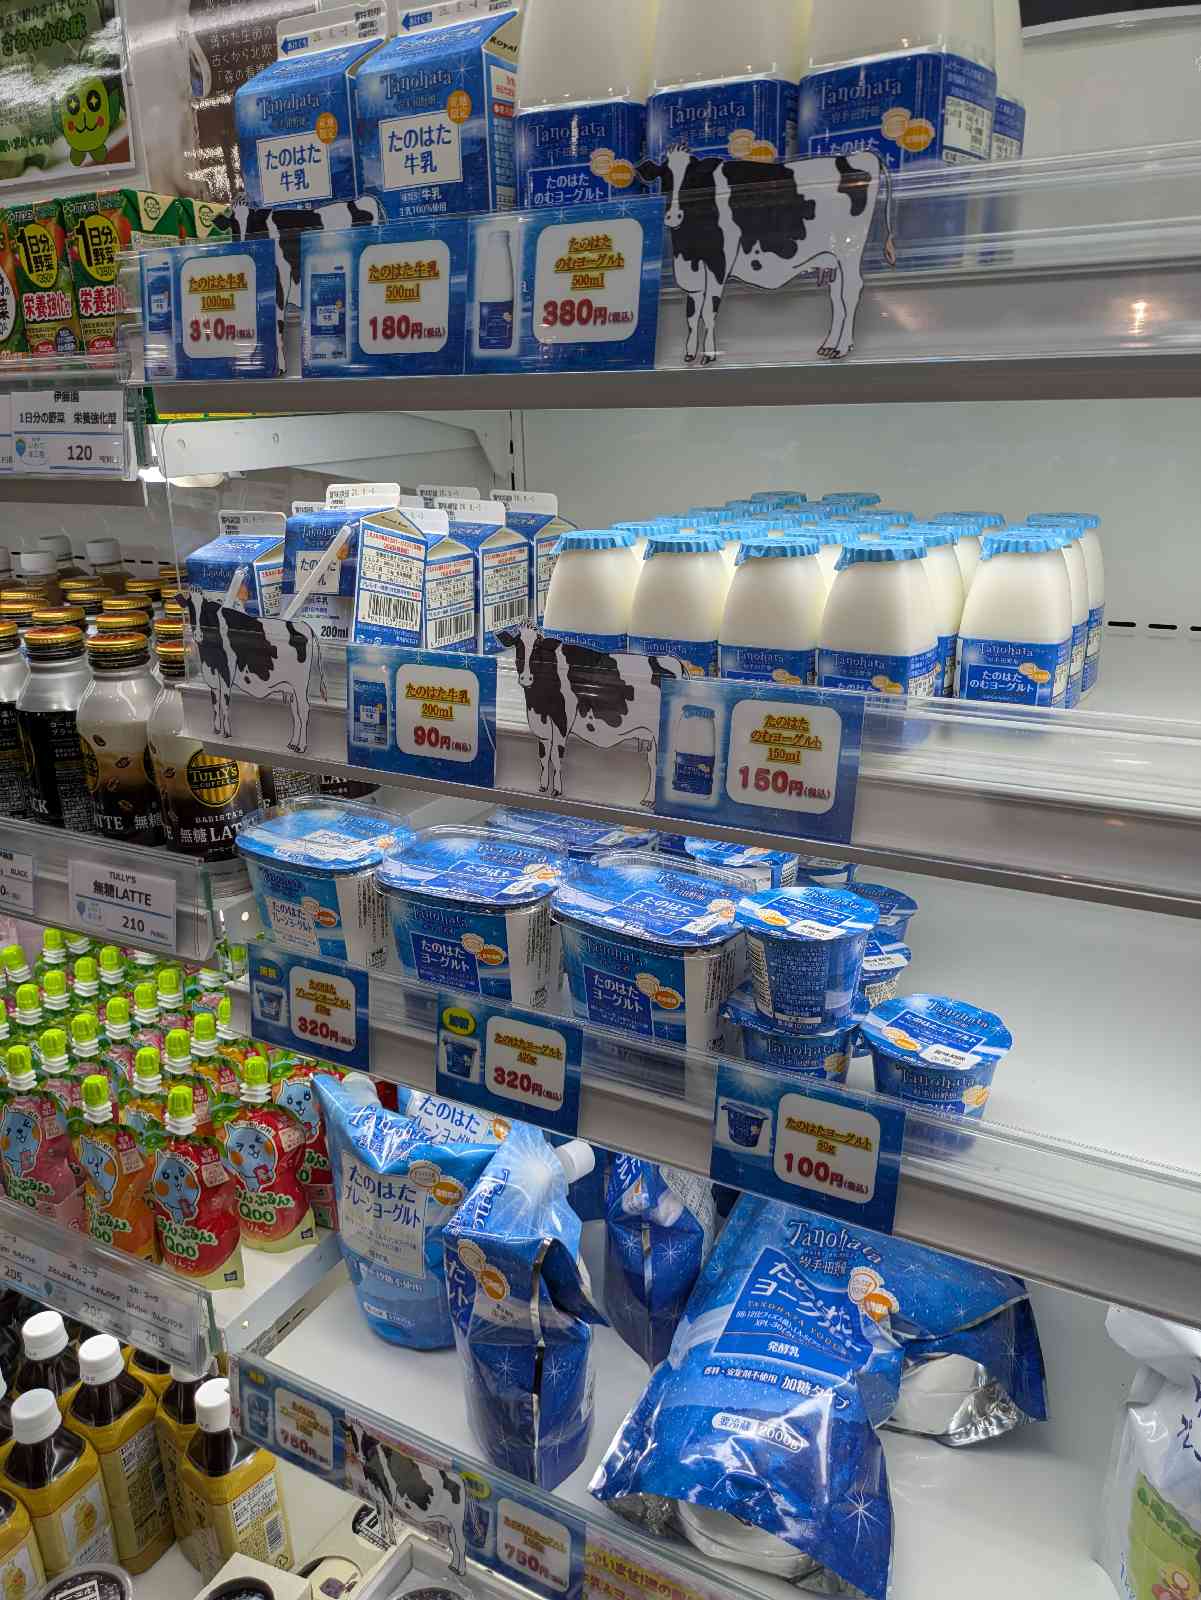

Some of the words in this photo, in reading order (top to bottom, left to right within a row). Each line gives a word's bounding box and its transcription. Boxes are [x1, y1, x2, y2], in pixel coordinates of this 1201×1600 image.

[821, 77, 902, 110] Tanohata
[665, 101, 746, 129] Tanohata
[388, 124, 452, 152] たのはた
[529, 121, 606, 148] Tanoata
[265, 144, 322, 170] たのはた
[403, 151, 437, 176] 牛乳
[279, 169, 310, 192] 牛乳
[546, 172, 589, 188] たのはた
[534, 187, 605, 206] のむヨーグルト
[567, 234, 613, 251] たのはた
[368, 260, 440, 282] たのはた牛乳
[554, 252, 625, 272] のむヨーグルト
[188, 273, 248, 292] たのはた牛乳
[572, 273, 605, 289] 500ml
[384, 284, 421, 301] 500ml
[19, 412, 66, 424] 1日分の野菜
[67, 446, 93, 461] 120
[320, 624, 349, 639] 200ml
[975, 642, 1034, 659] Tanohata
[969, 679, 1035, 693] のむヨーグルト
[982, 669, 1024, 683] たのはた
[405, 682, 470, 705] たのはた牛乳
[764, 714, 810, 731] たのはた
[749, 729, 823, 750] のむヨーグルト
[10, 867, 29, 878] BLACK
[109, 871, 137, 884] TULLY'S
[92, 880, 153, 906] 無糖LATTE
[122, 915, 145, 932] 210
[421, 939, 466, 960] たのはた
[421, 953, 470, 971] ヨーグルト
[592, 974, 640, 1000] たのはた
[591, 989, 644, 1012] ヨーグルト
[419, 1095, 481, 1134] たのはた
[784, 1116, 873, 1152] たのはたヨーグルト
[349, 1165, 417, 1204] たのはた
[239, 1202, 276, 1223] Qoo
[344, 1183, 421, 1230] プレーンヨーグルト
[164, 1234, 198, 1259] Qoo
[788, 1220, 883, 1264] Tanohata
[4, 1265, 23, 1283] 205
